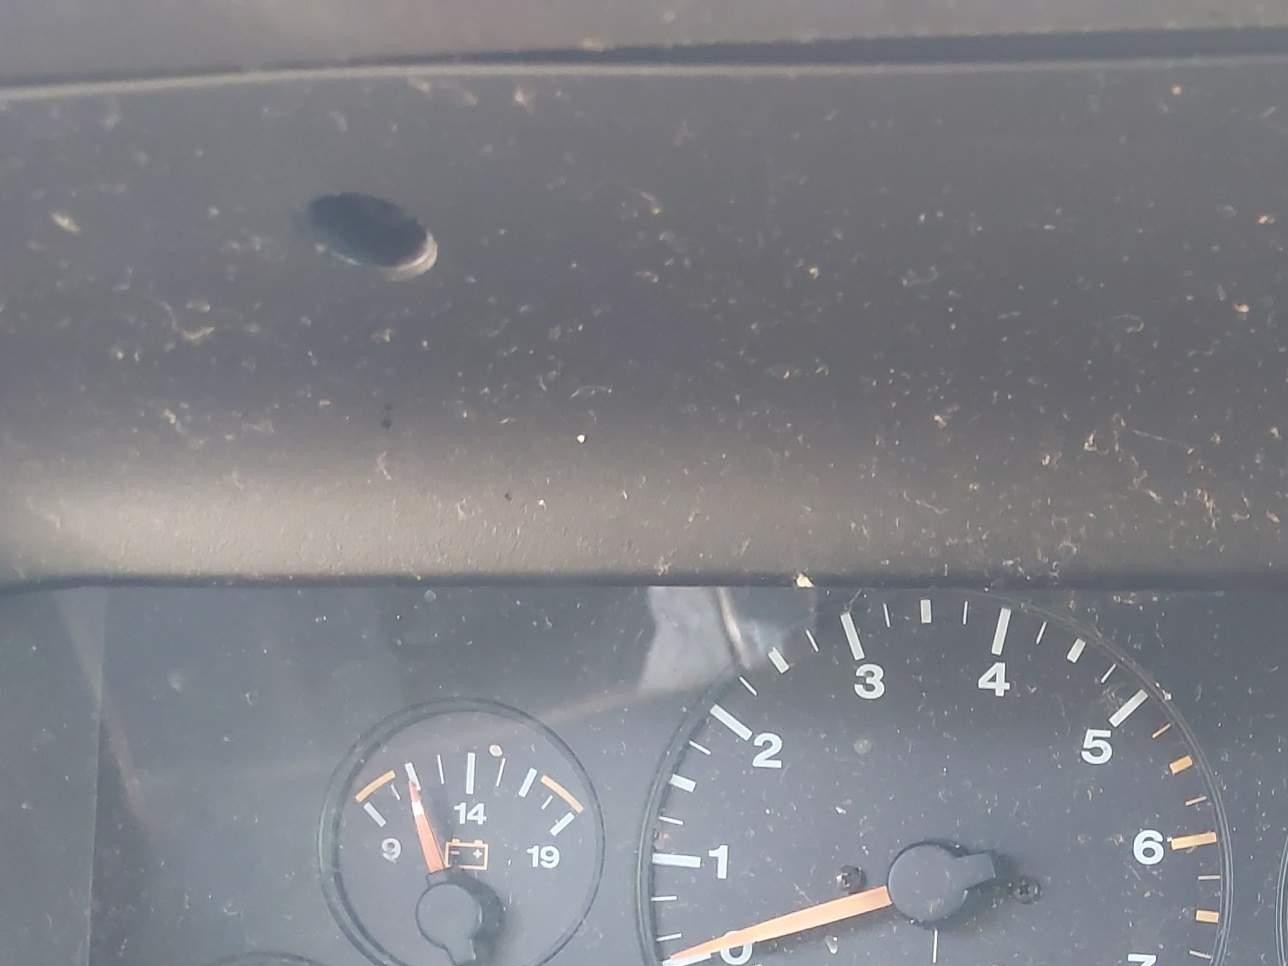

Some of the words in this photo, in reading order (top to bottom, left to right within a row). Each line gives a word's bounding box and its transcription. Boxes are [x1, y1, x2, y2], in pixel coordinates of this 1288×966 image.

[855, 664, 885, 699] 3
[978, 662, 1010, 696] 4
[752, 733, 783, 768] 2
[1081, 729, 1113, 764] 5
[454, 803, 487, 825] 14
[381, 838, 401, 861] 9
[527, 845, 560, 868] 19
[708, 845, 728, 879] 1
[1133, 830, 1165, 864] 6
